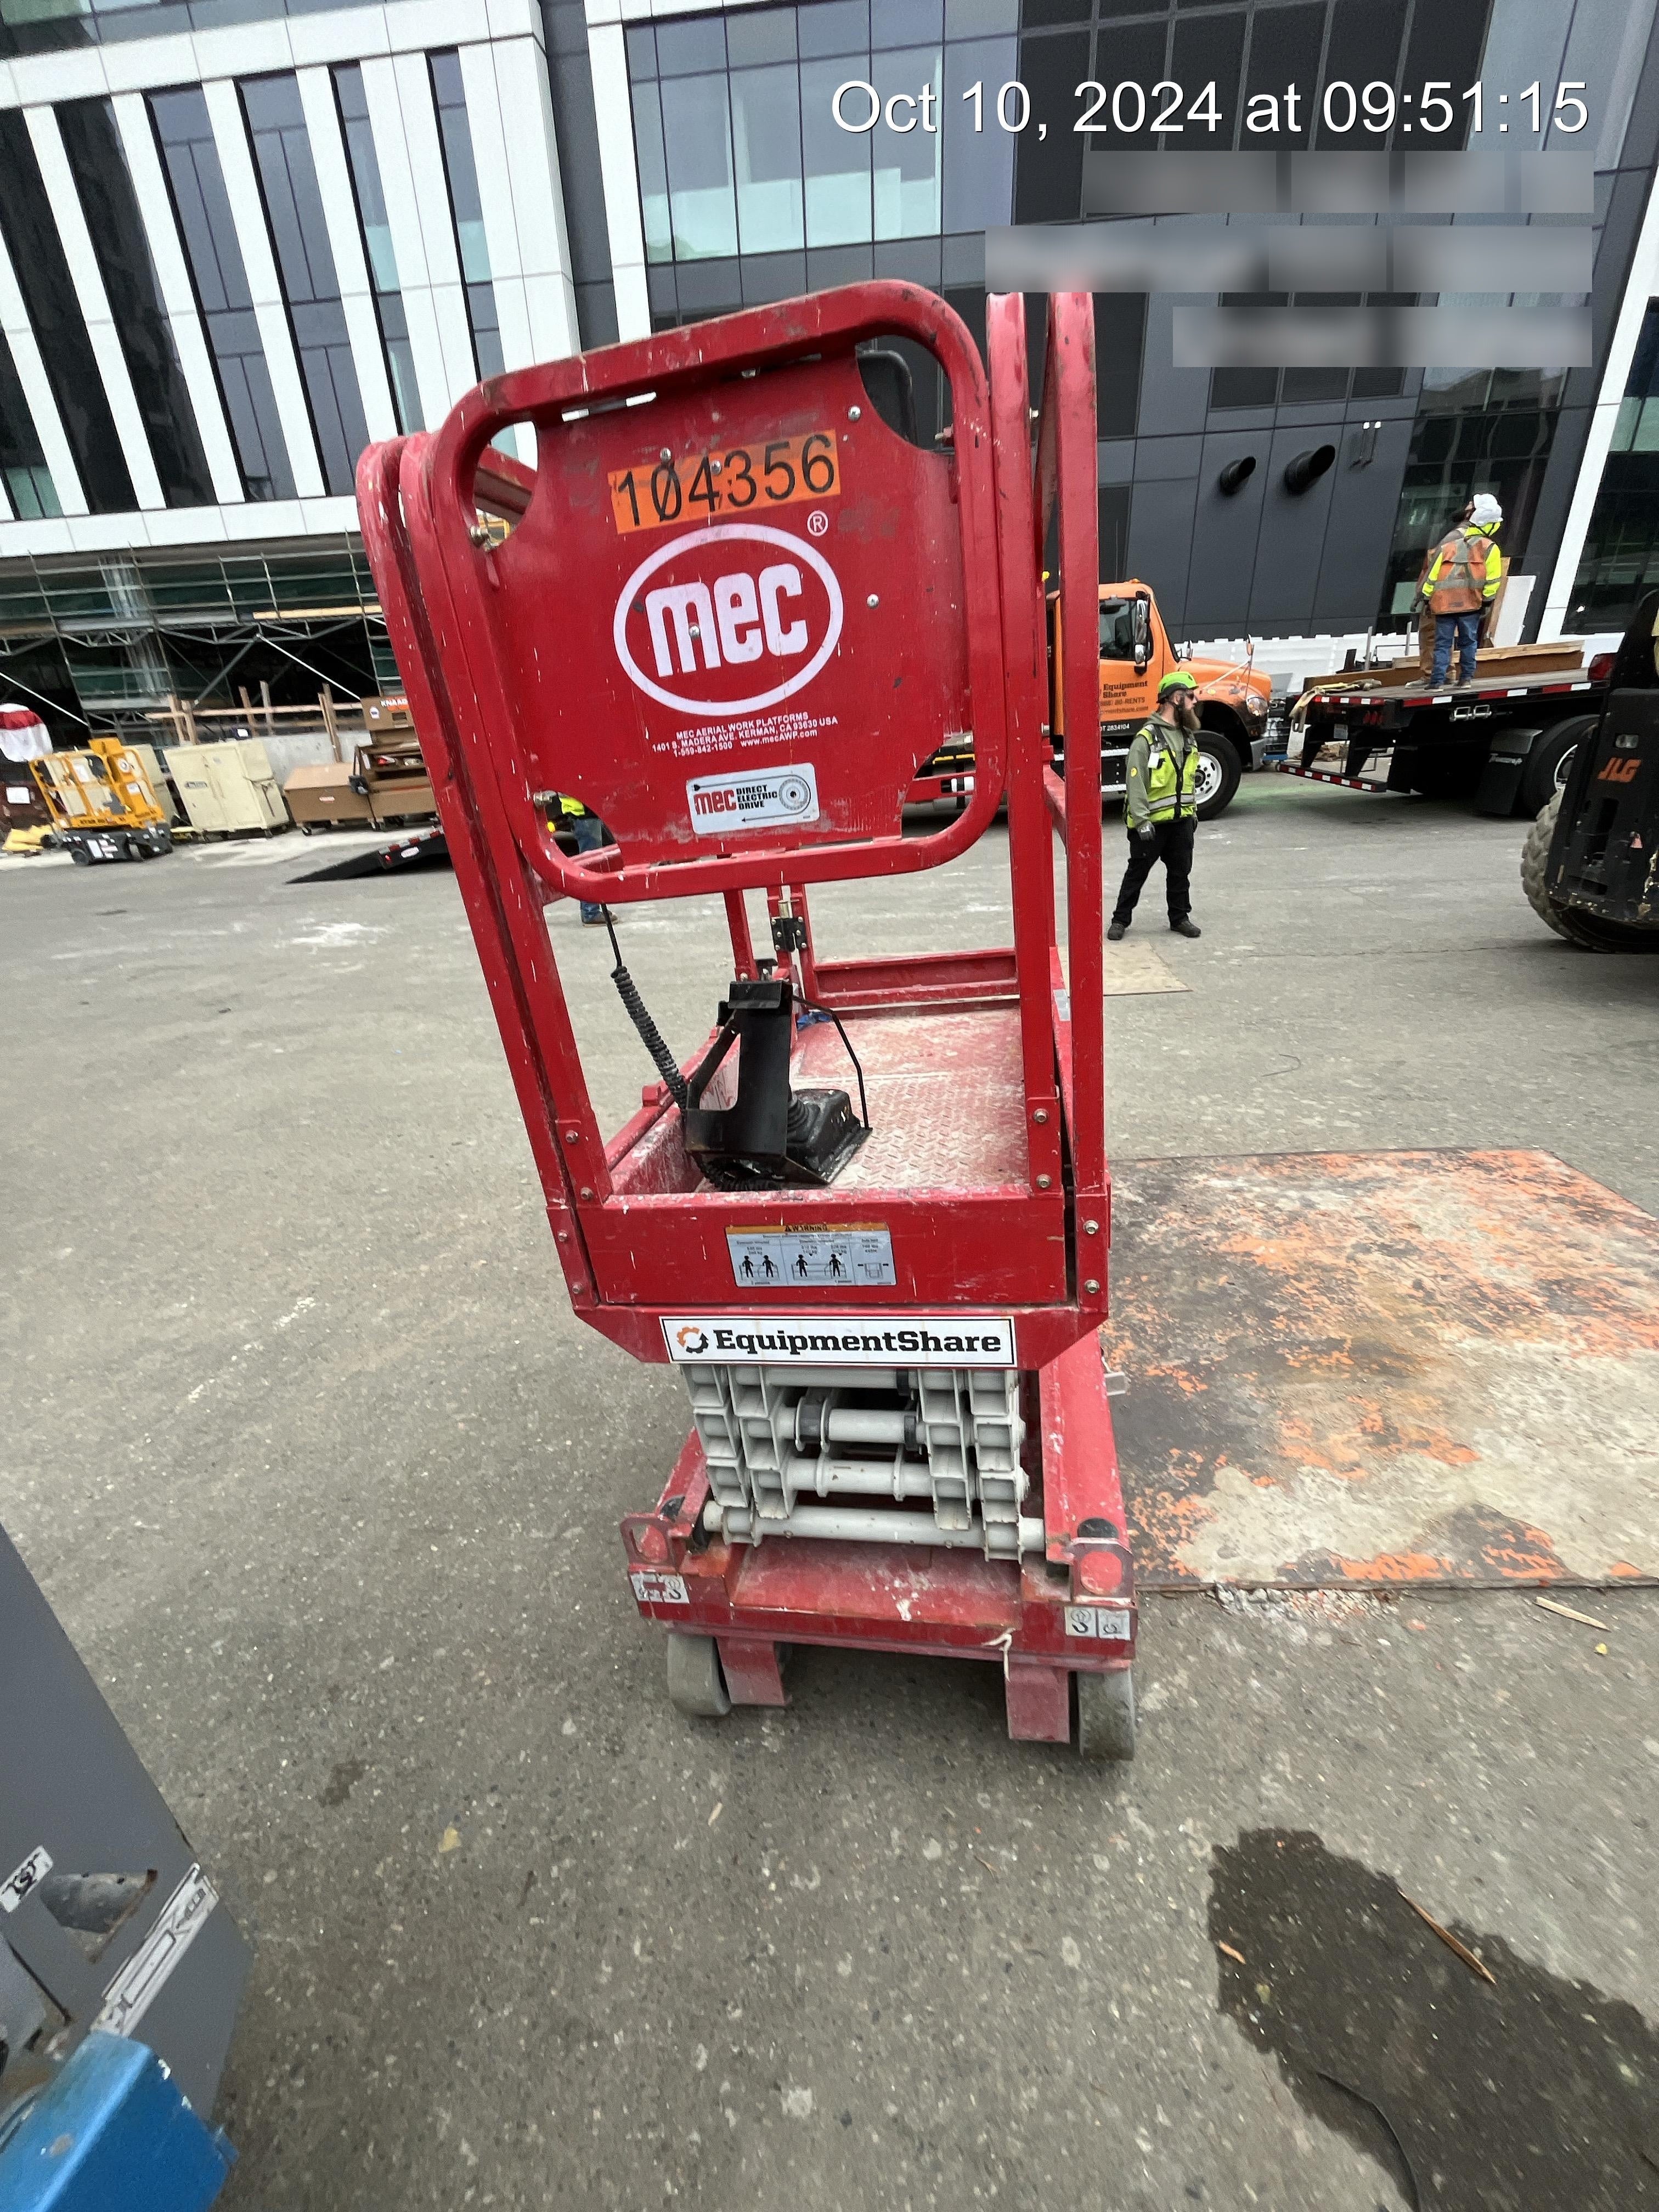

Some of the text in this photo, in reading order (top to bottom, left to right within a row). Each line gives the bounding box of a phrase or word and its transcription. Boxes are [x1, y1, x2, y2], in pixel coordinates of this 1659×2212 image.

[618, 435, 834, 527] 104356
[1103, 680, 1148, 691] Equipment
[652, 741, 670, 752] 1401
[681, 735, 718, 748] MADERA
[738, 725, 778, 740] KERMAN,
[780, 723, 792, 733] CA
[819, 715, 838, 727] USA
[676, 712, 809, 741] MEC AERIAL WORK PLATFORMS
[1598, 757, 1641, 783] JLG
[736, 785, 768, 795] DIRECT
[737, 791, 778, 803] ELECTRIC
[738, 800, 765, 810] DRIVE
[714, 1328, 1001, 1355] EquipmentShare
